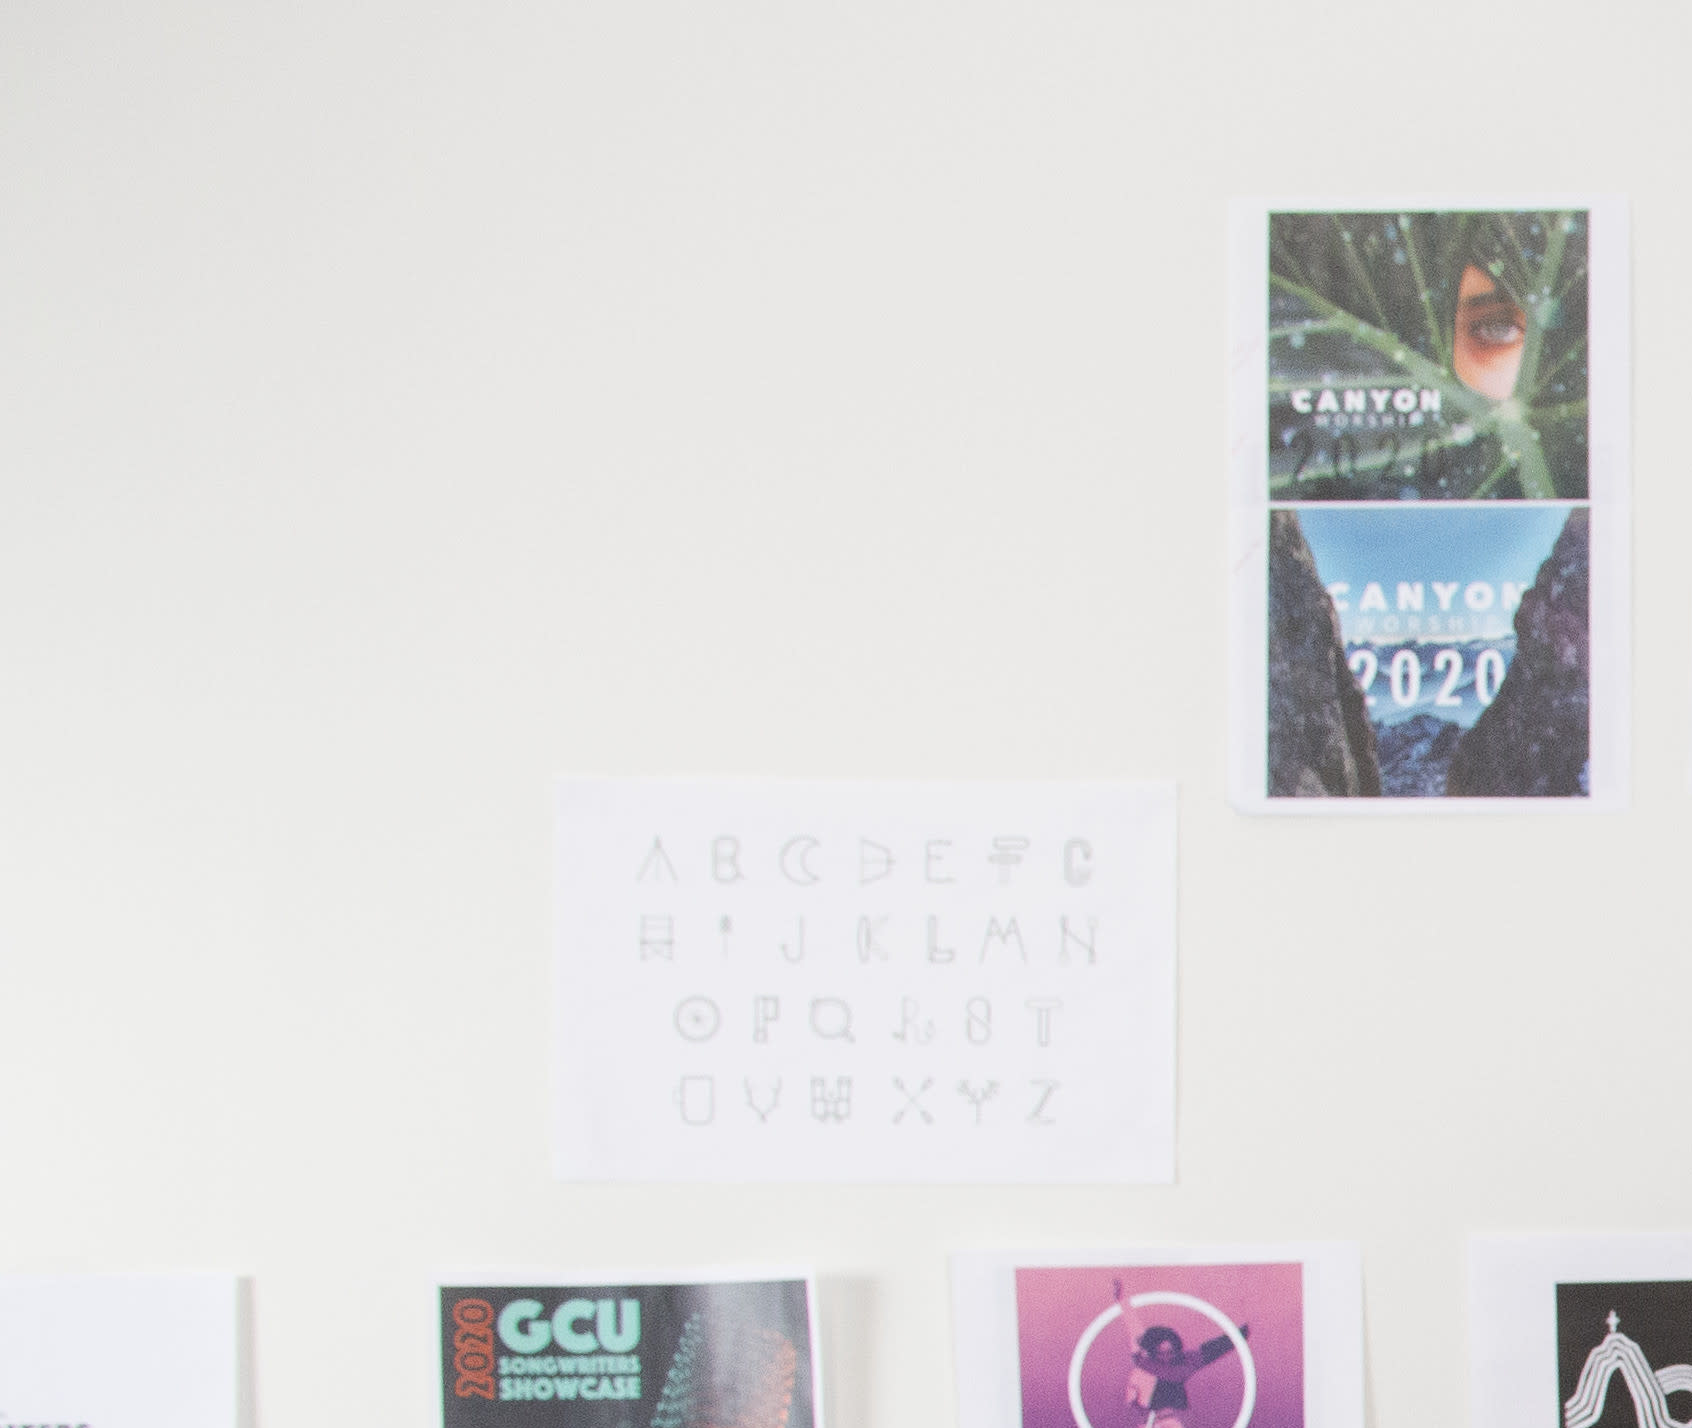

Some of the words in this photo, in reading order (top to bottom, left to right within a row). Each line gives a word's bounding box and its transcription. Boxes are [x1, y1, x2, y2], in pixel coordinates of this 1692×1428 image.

[1290, 389, 1442, 413] CANYON
[1326, 581, 1528, 611] CANYON
[1349, 649, 1506, 707] 2020
[498, 1298, 641, 1354] GCU
[453, 1298, 495, 1401] 2020
[500, 1355, 641, 1376] SONGWRITERS
[500, 1376, 641, 1400] SHOWCASE
